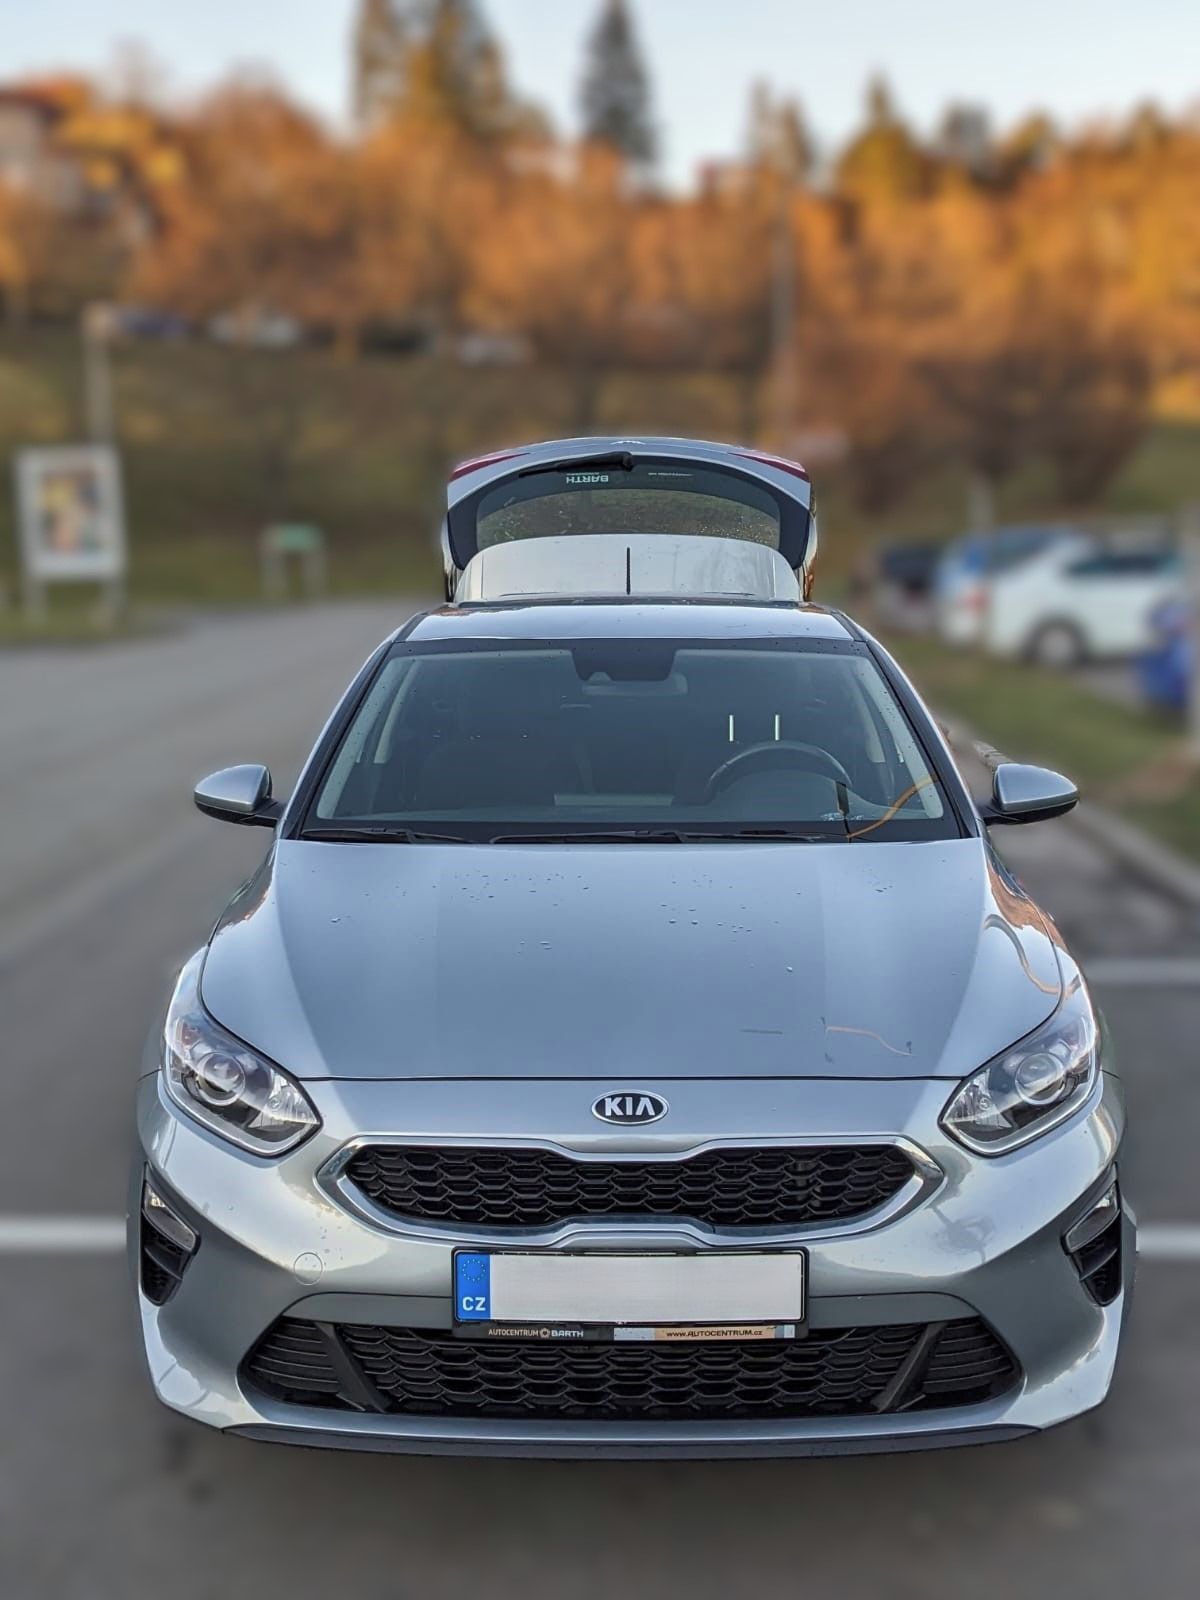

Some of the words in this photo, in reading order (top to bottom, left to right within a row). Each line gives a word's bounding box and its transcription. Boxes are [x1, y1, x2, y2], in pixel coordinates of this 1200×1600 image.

[566, 475, 609, 484] BARTH
[604, 1096, 656, 1117] KIA
[462, 1296, 486, 1311] CZ
[488, 1328, 539, 1337] AUTOCENTRUM
[551, 1329, 584, 1338] BARTH
